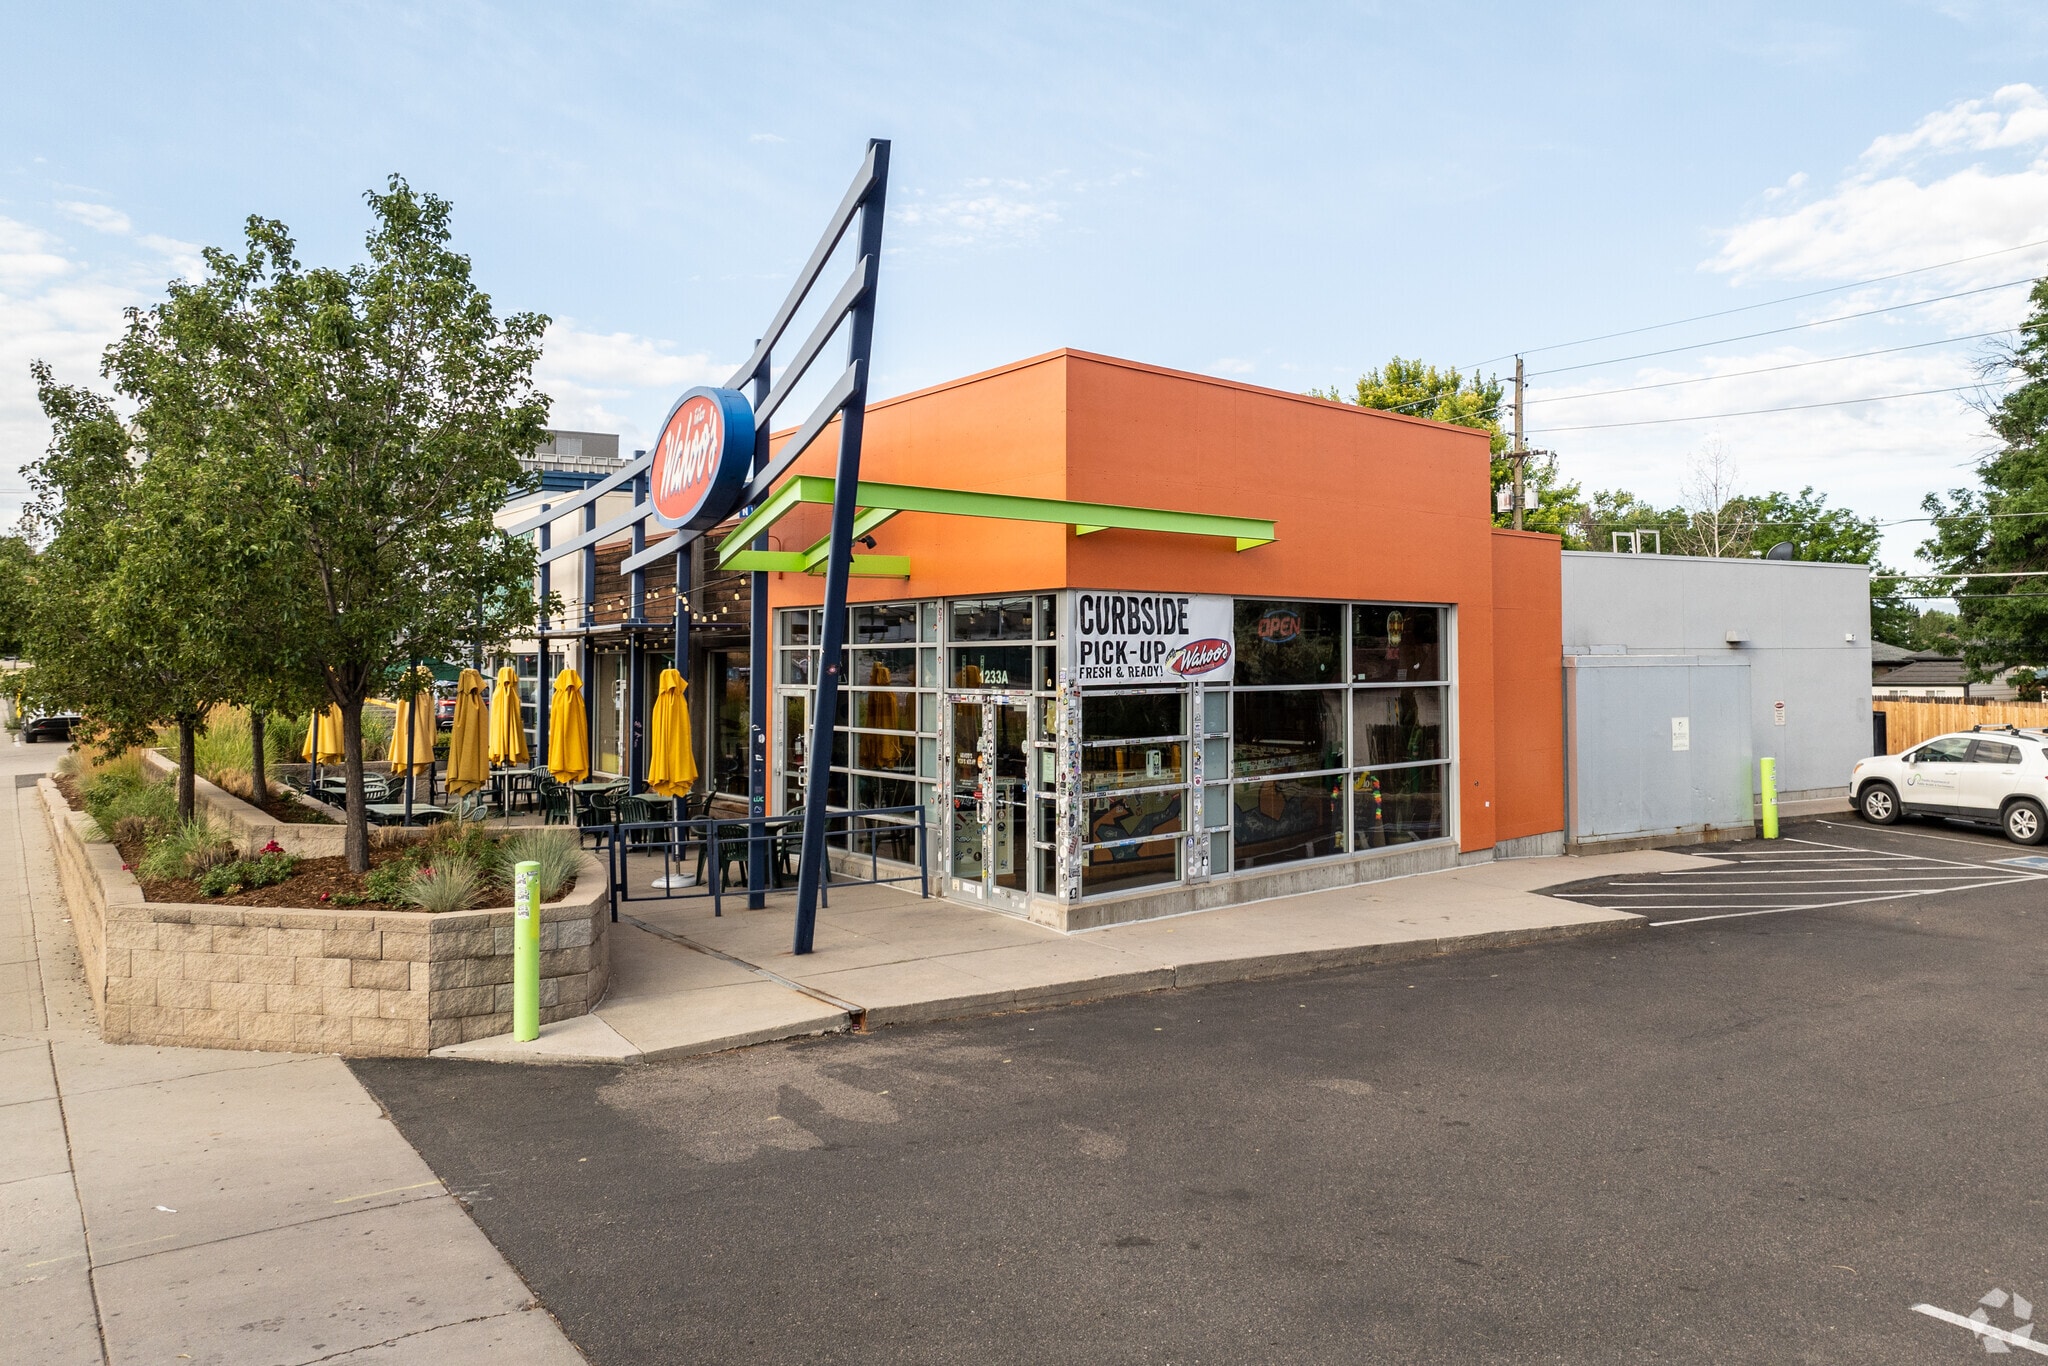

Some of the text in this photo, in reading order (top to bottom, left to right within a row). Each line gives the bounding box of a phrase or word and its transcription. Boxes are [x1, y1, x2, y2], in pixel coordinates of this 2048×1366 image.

[660, 405, 718, 503] Wahoo's
[1080, 594, 1189, 635] CURBSIDE
[1257, 616, 1301, 638] OPEN
[1080, 640, 1166, 665] PICK-UP
[1180, 642, 1228, 672] Wahoo's
[980, 670, 1009, 684] 1233A
[1079, 665, 1164, 679] FRESH & READY!
